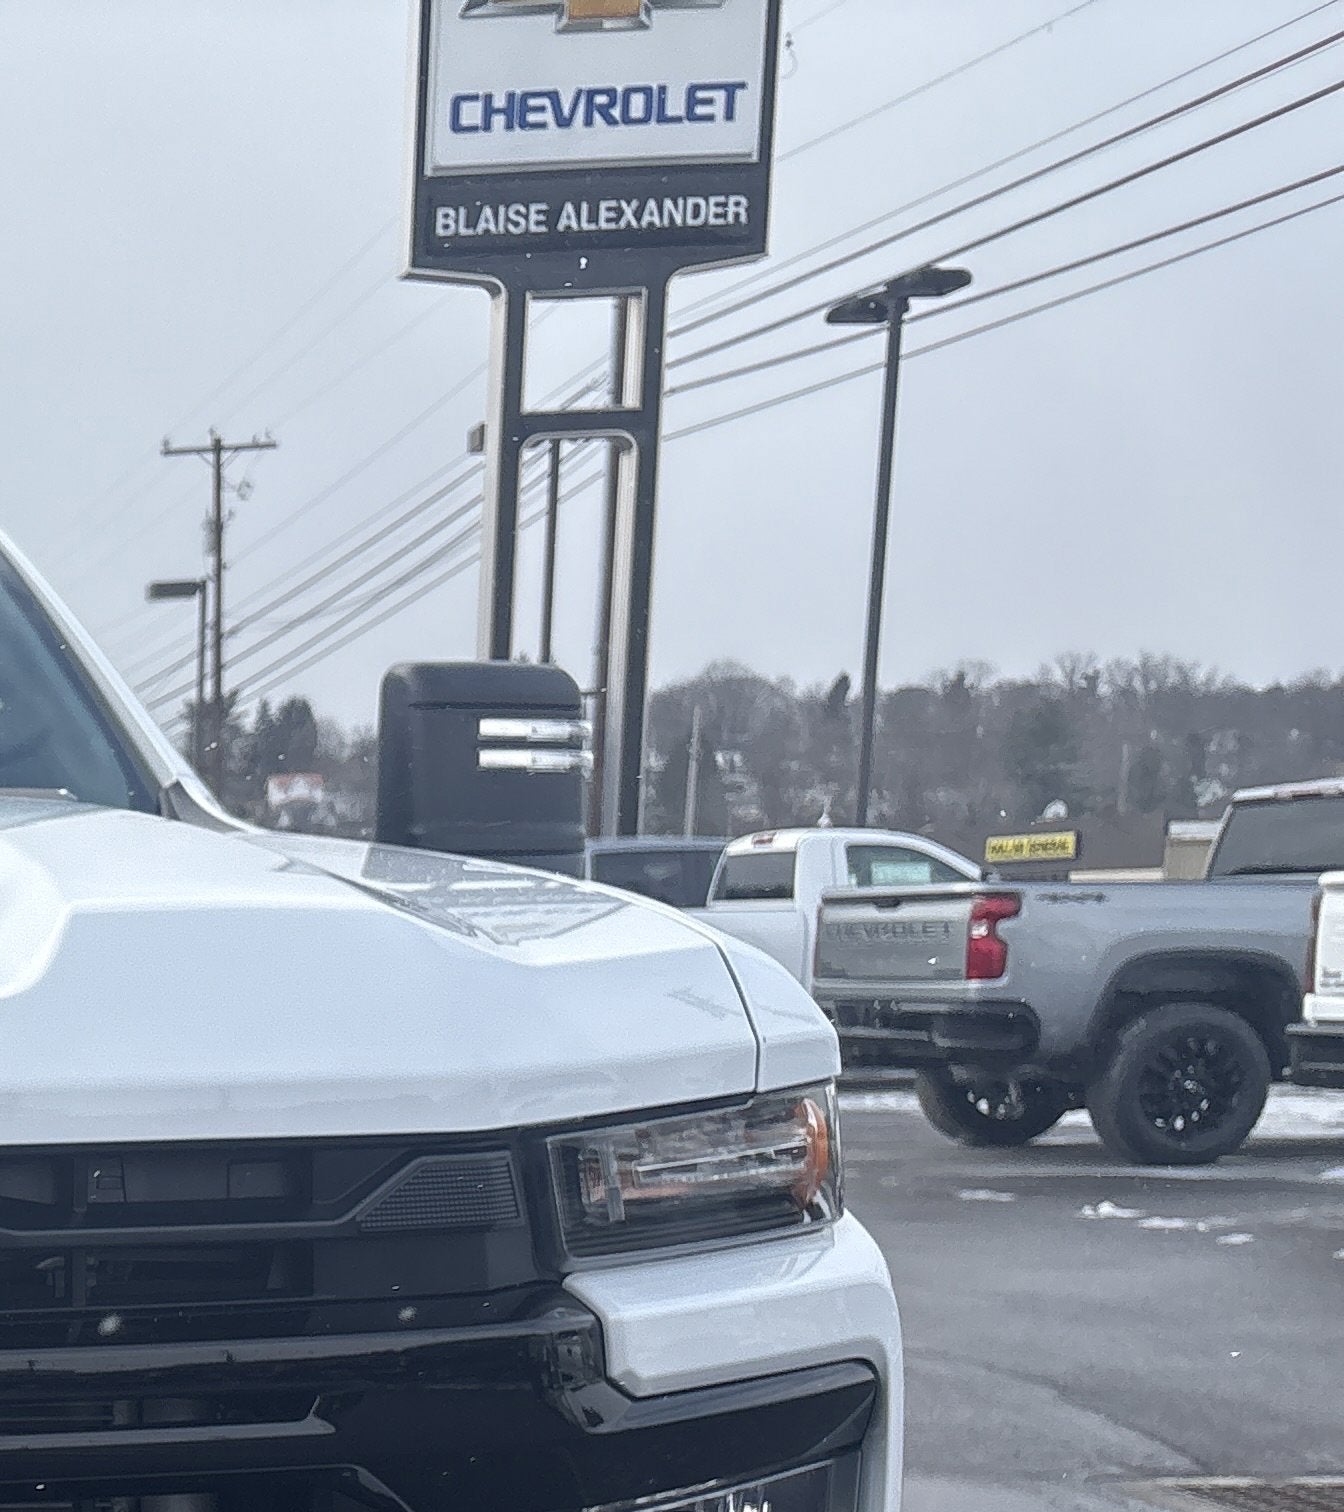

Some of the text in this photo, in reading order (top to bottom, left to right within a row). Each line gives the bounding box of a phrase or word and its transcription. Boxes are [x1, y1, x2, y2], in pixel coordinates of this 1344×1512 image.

[450, 81, 749, 134] CHEVROLET
[435, 194, 749, 237] BLAISE ALEXANDER
